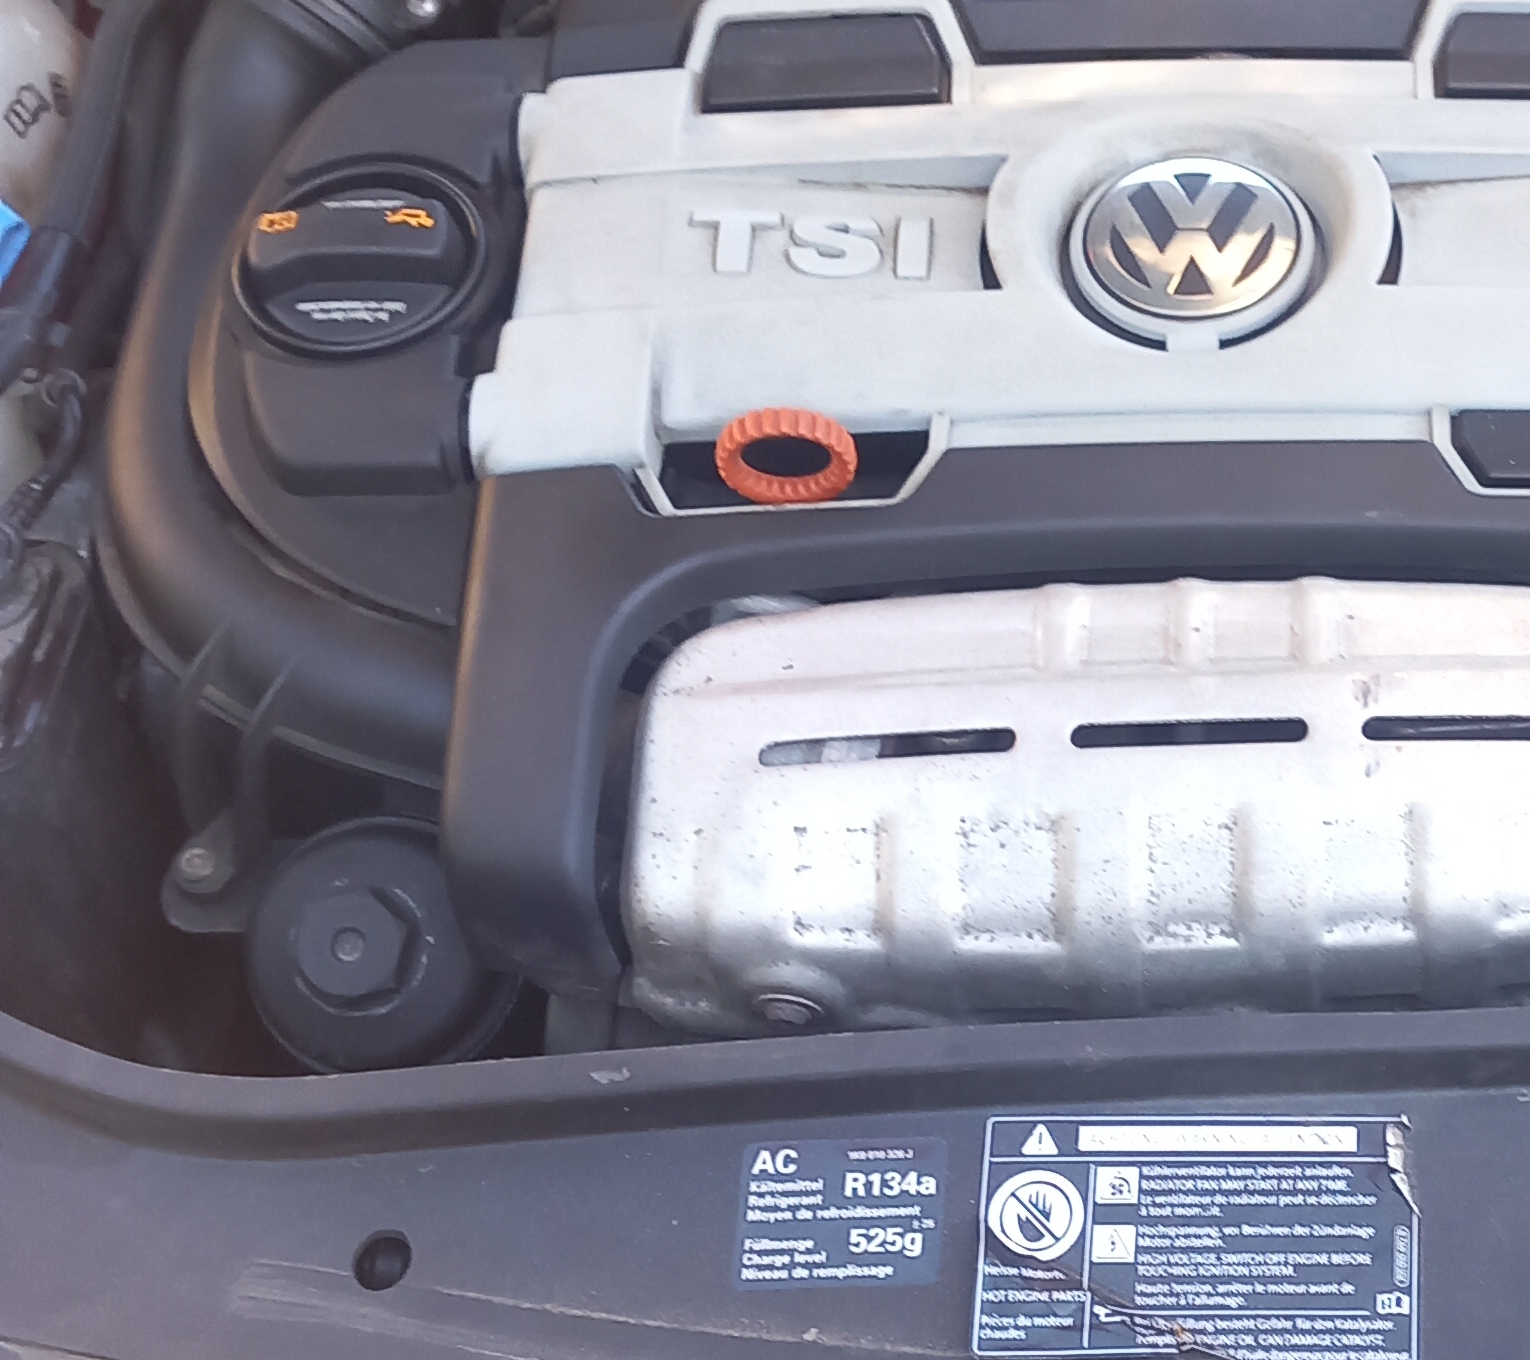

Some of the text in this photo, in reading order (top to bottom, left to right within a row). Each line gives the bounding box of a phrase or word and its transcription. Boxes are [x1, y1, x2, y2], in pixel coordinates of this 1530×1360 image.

[689, 209, 934, 281] TSI
[751, 1148, 799, 1175] AC
[844, 1171, 937, 1197] R134a
[1196, 1179, 1219, 1191] FAN
[1220, 1179, 1245, 1191] MAY
[1244, 1179, 1279, 1191] START
[1279, 1179, 1294, 1191] AT
[1295, 1179, 1319, 1191] ANY
[747, 1194, 824, 1209] Refrigerant
[746, 1205, 922, 1223] Moyen de refroidissement
[743, 1239, 815, 1252] Füllmenge
[849, 1227, 923, 1257] 525g
[742, 1251, 828, 1267] Charge level
[1286, 1253, 1330, 1265] ENGINE
[1330, 1253, 1373, 1265] BEFORE
[740, 1264, 895, 1281] Niveau de remplissage
[982, 1290, 1007, 1302] HOT
[1007, 1290, 1051, 1302] ENGINE
